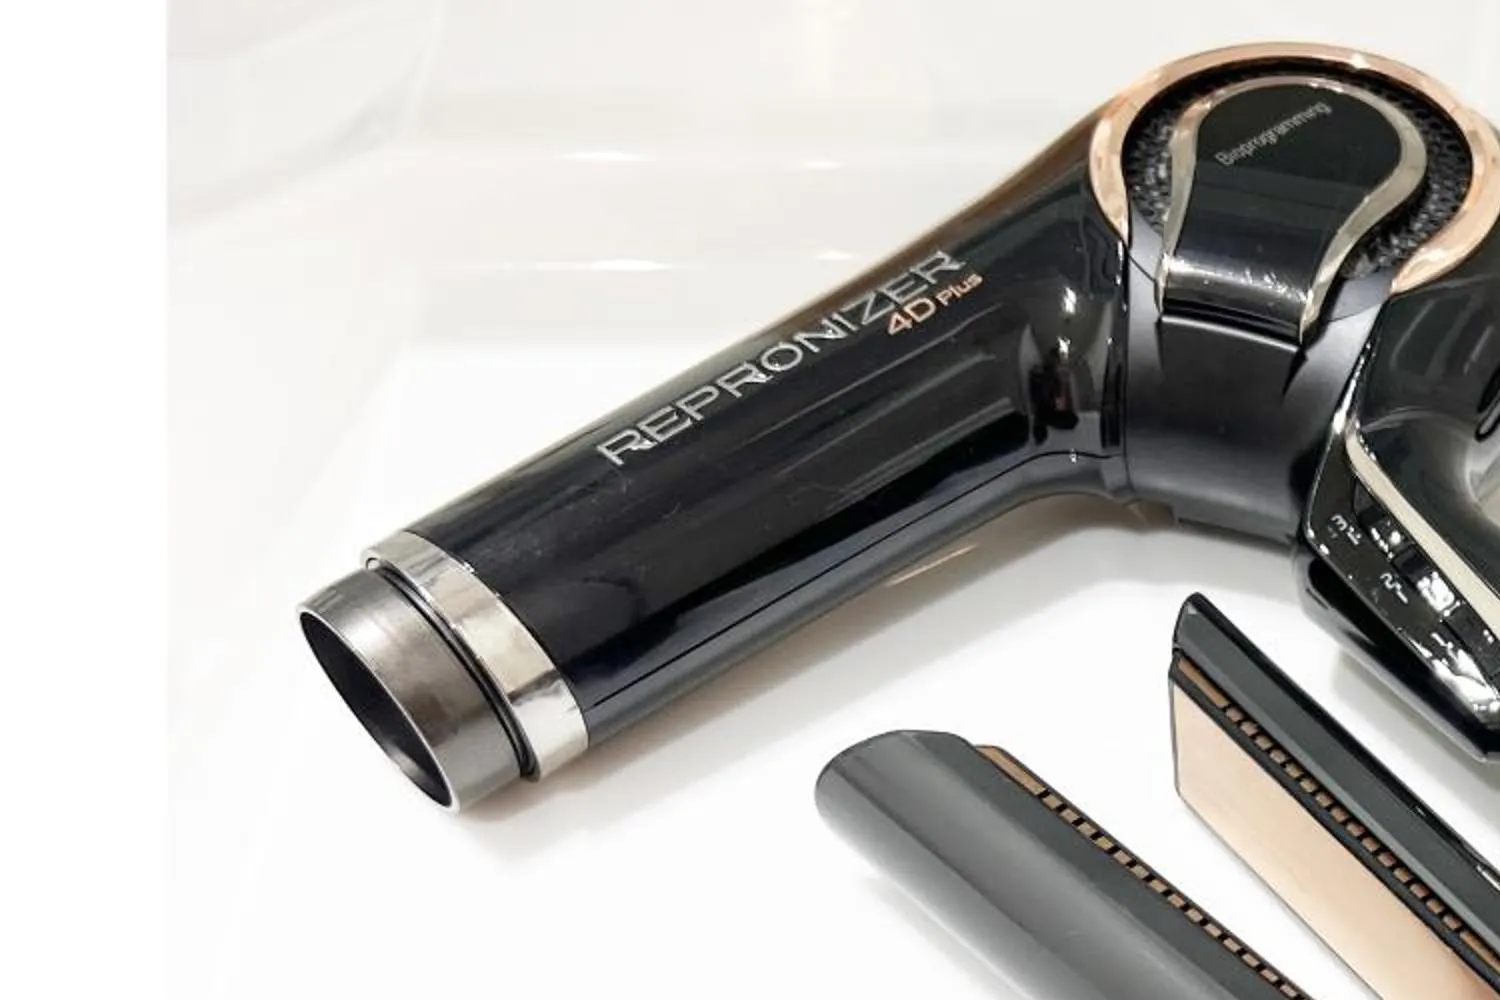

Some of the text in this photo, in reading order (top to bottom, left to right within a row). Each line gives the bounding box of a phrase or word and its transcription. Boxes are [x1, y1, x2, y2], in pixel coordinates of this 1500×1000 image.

[1214, 102, 1332, 166] Bioprogramming
[886, 273, 983, 336] 4D Plus
[597, 250, 965, 466] REPRONIZER
